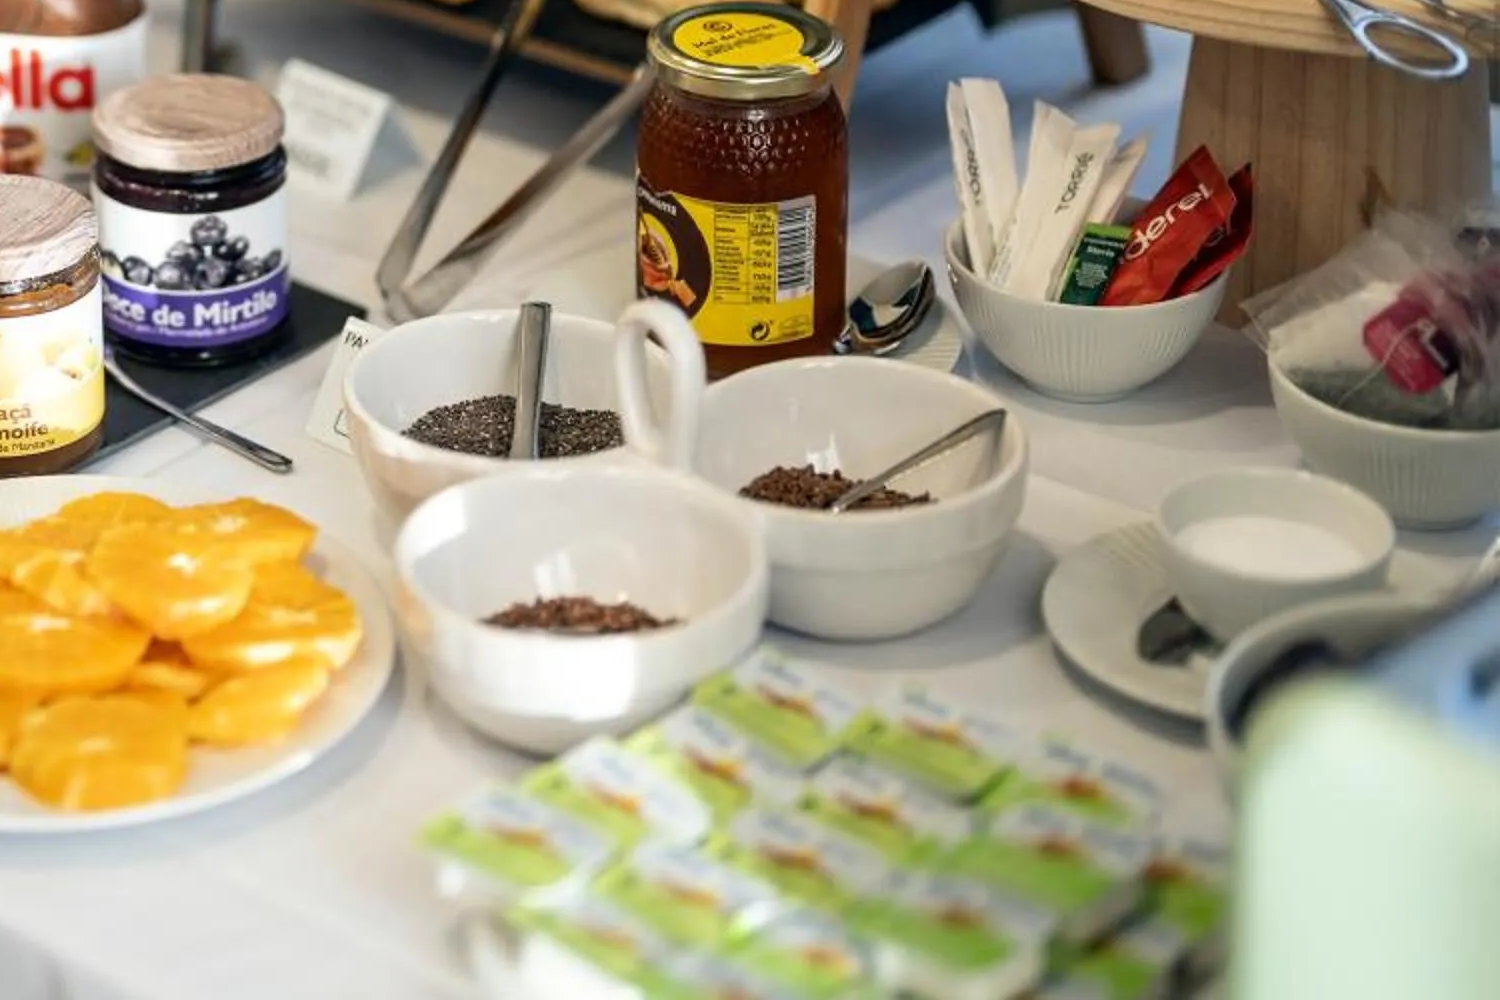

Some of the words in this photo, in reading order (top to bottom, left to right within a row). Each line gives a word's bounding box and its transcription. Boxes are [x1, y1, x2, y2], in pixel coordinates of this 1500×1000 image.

[1119, 183, 1214, 264] derel
[152, 304, 186, 328] de
[193, 290, 277, 327] Mirtilo
